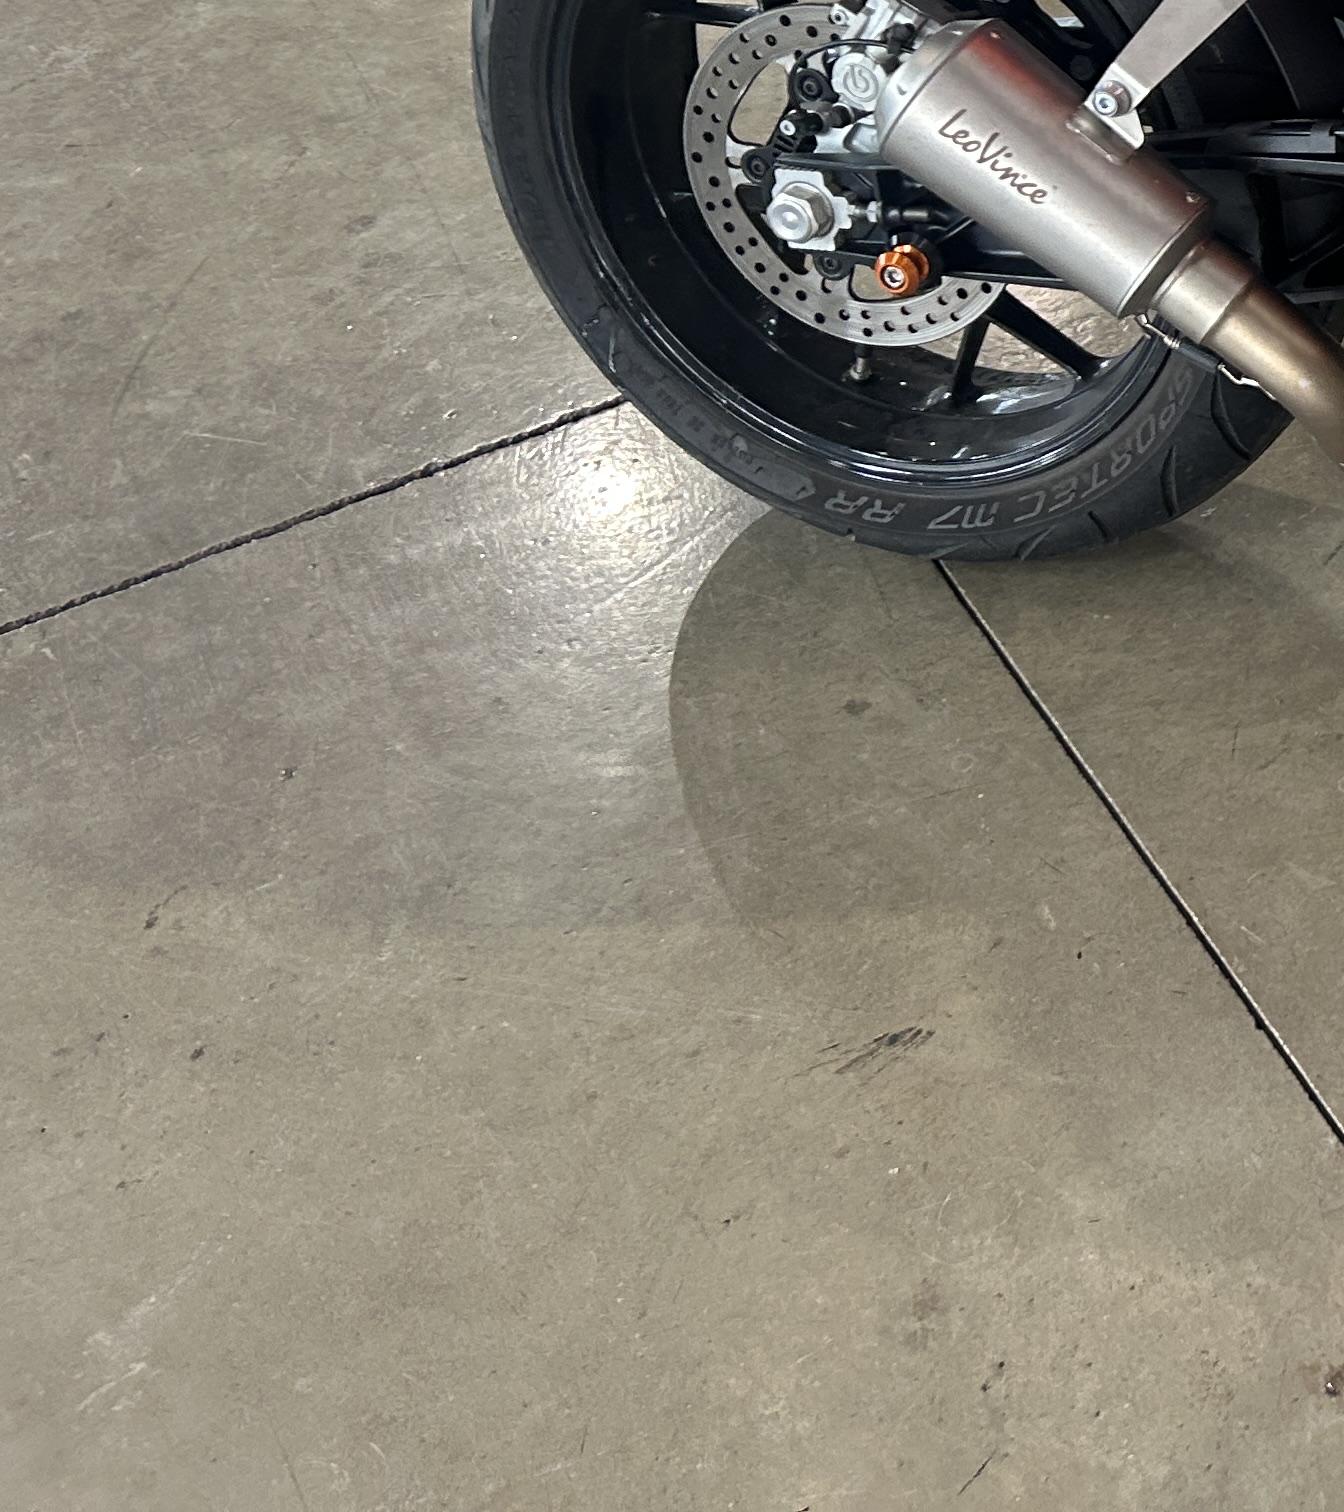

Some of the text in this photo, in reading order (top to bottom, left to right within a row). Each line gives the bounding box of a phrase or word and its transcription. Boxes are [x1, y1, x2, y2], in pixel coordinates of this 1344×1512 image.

[938, 108, 1048, 205] LeoVince
[1013, 368, 1193, 523] SPORTEC
[824, 493, 906, 525] RR
